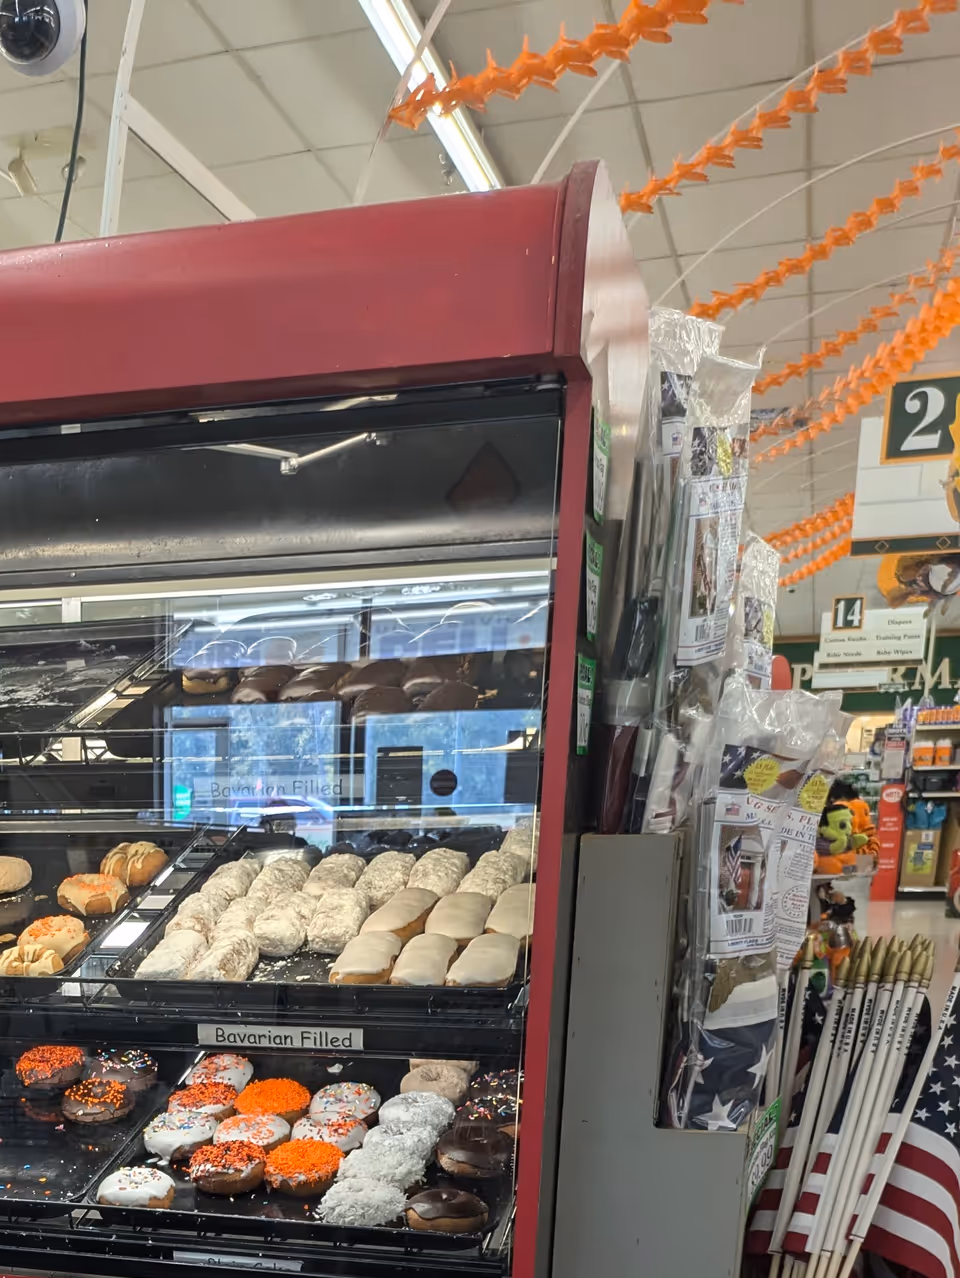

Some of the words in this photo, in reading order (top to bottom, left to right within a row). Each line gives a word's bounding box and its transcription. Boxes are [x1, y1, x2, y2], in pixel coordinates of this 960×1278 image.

[900, 387, 945, 451] 2
[835, 599, 862, 628] 14
[211, 782, 286, 798] Bavarian
[293, 778, 343, 796] Filled
[215, 1027, 294, 1047] Bavarian
[301, 1030, 352, 1048] Filled
